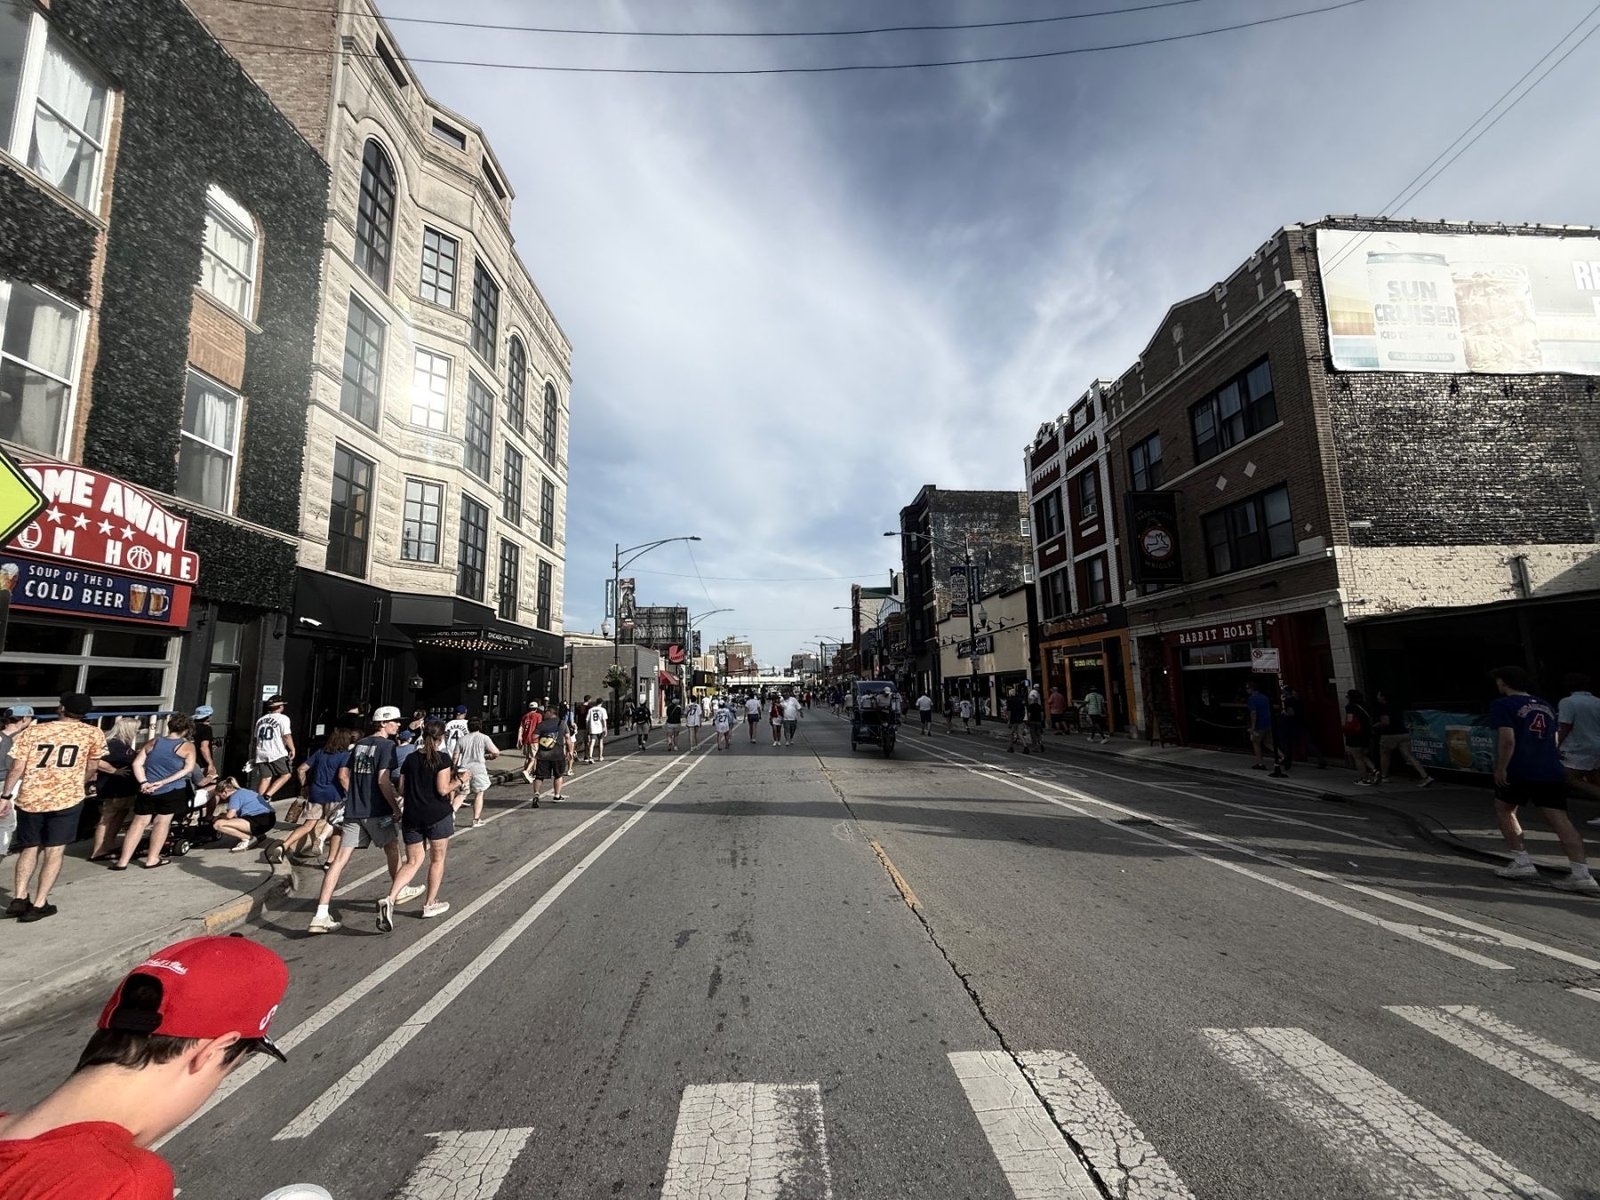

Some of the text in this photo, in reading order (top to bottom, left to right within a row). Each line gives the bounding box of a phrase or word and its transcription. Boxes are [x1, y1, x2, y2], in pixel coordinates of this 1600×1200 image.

[1387, 280, 1438, 302] SUN
[1374, 303, 1458, 326] CRUISER
[100, 481, 183, 549] AWAY
[29, 564, 61, 579] SOUP
[65, 568, 78, 582] OF
[83, 573, 103, 586] THE
[24, 579, 125, 609] COLD BEER
[1179, 624, 1254, 644] RABBIT HOLE
[258, 726, 275, 741] 40
[1528, 713, 1546, 739] 4
[36, 744, 80, 769] 70
